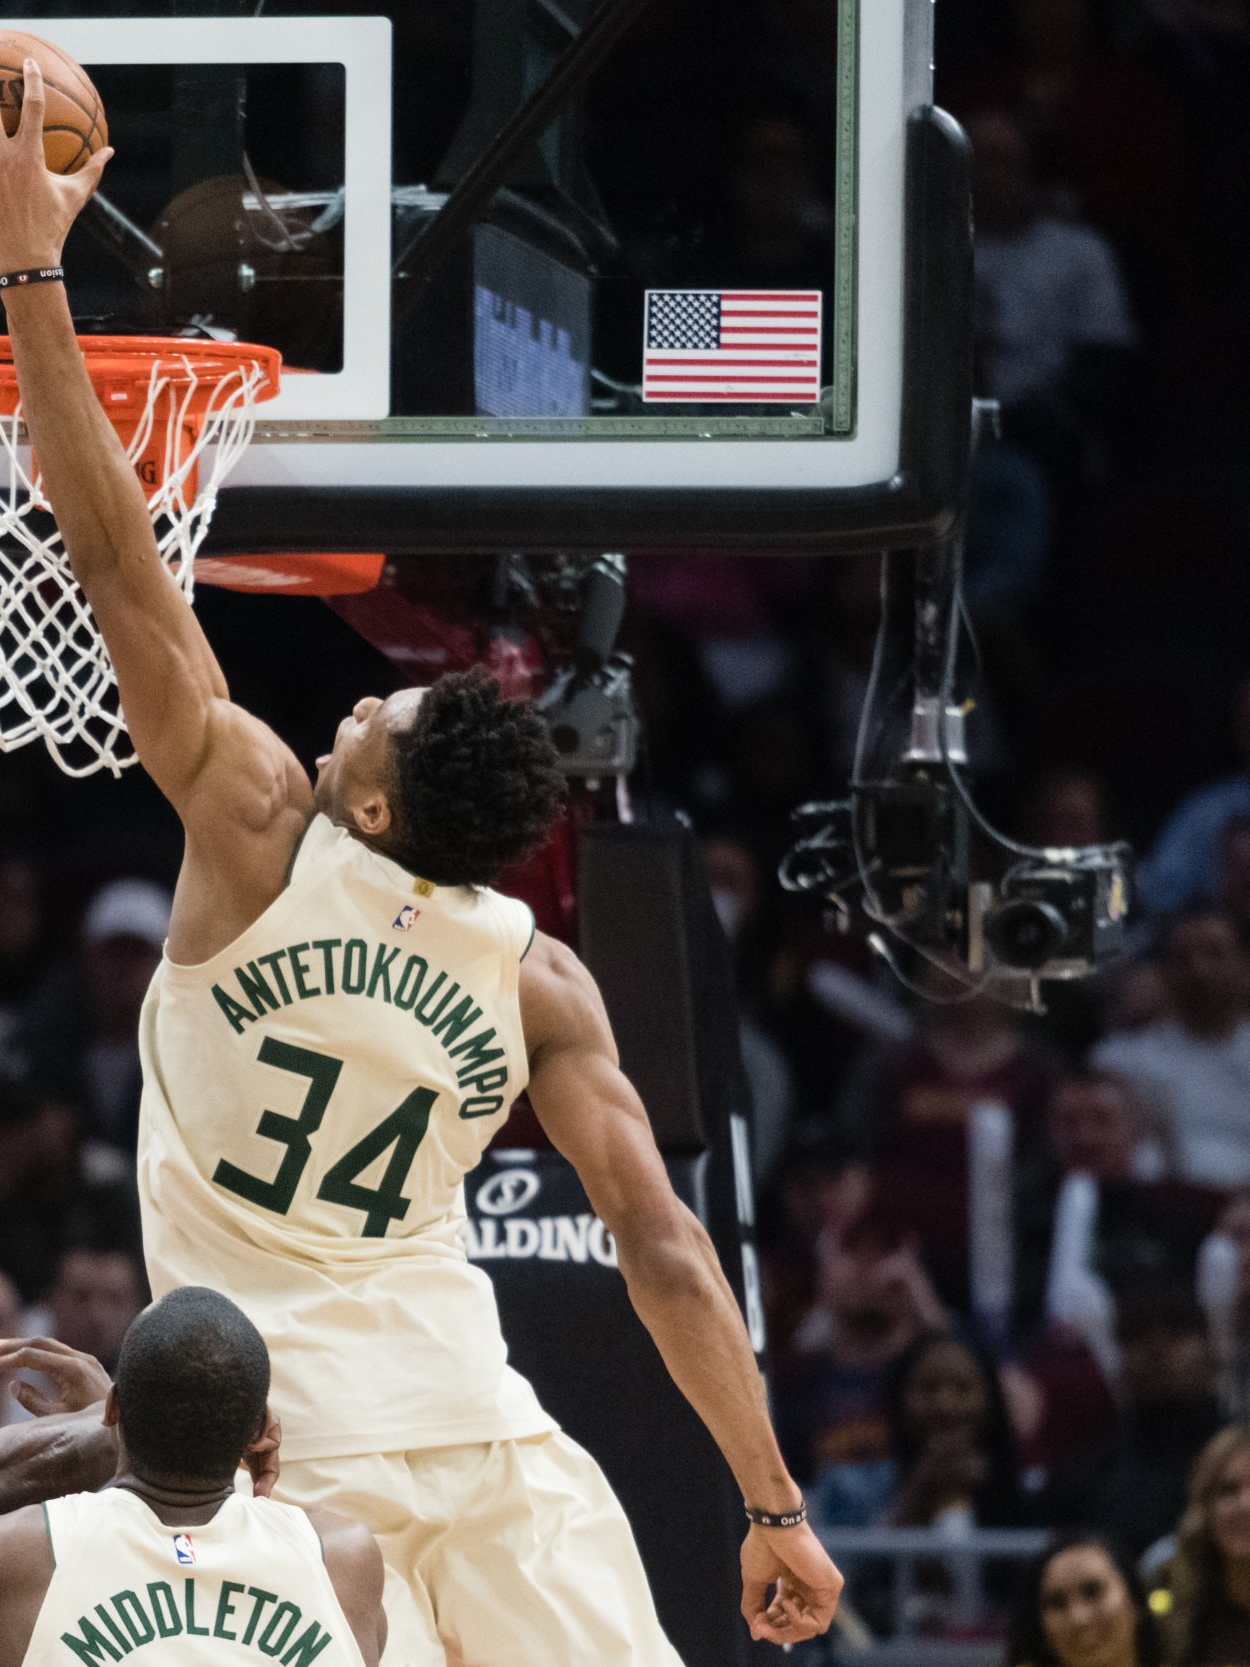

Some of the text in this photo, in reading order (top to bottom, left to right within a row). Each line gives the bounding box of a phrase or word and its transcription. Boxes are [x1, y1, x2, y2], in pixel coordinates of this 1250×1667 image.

[210, 938, 509, 1120] ANTETOKOUNMPO
[211, 1035, 440, 1239] 34
[60, 1578, 333, 1667] MIDDLETON
